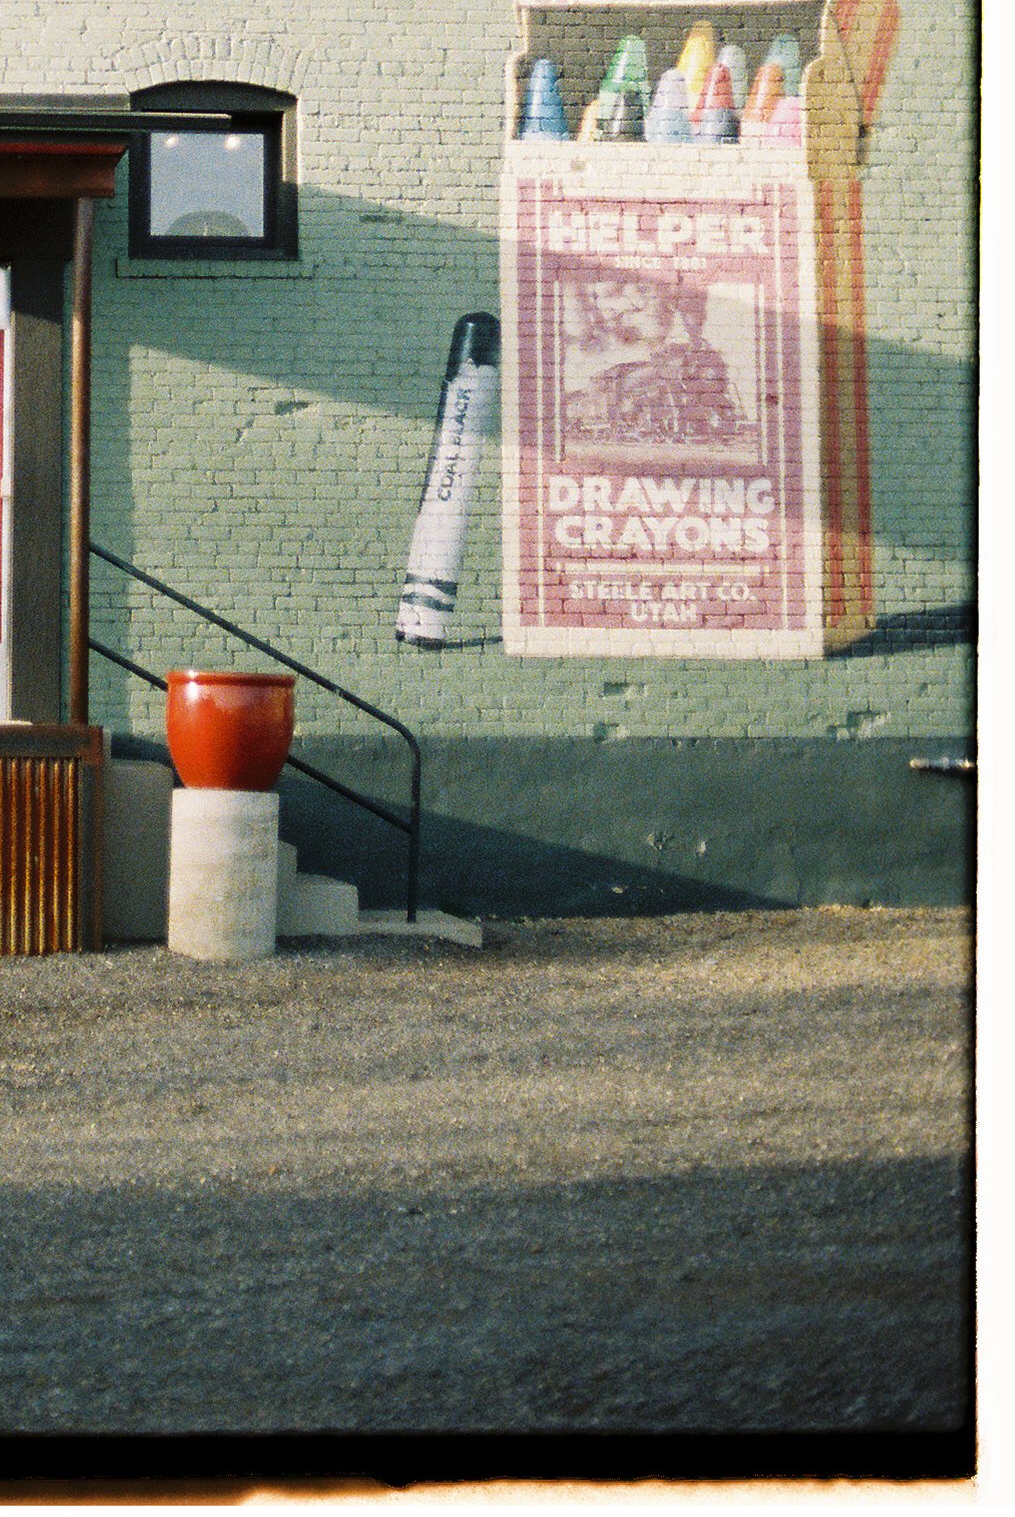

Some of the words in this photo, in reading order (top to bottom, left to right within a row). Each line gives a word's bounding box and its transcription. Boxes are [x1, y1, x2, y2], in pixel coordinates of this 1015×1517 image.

[548, 212, 770, 254] HELPER
[437, 453, 460, 503] COAL
[453, 386, 473, 447] BLACK
[548, 476, 776, 514] DRAWING
[554, 516, 770, 553] CRAYONS
[569, 580, 653, 601] STEELE
[661, 581, 710, 601] ART
[718, 582, 758, 602] CO.
[630, 602, 698, 623] UTAH
